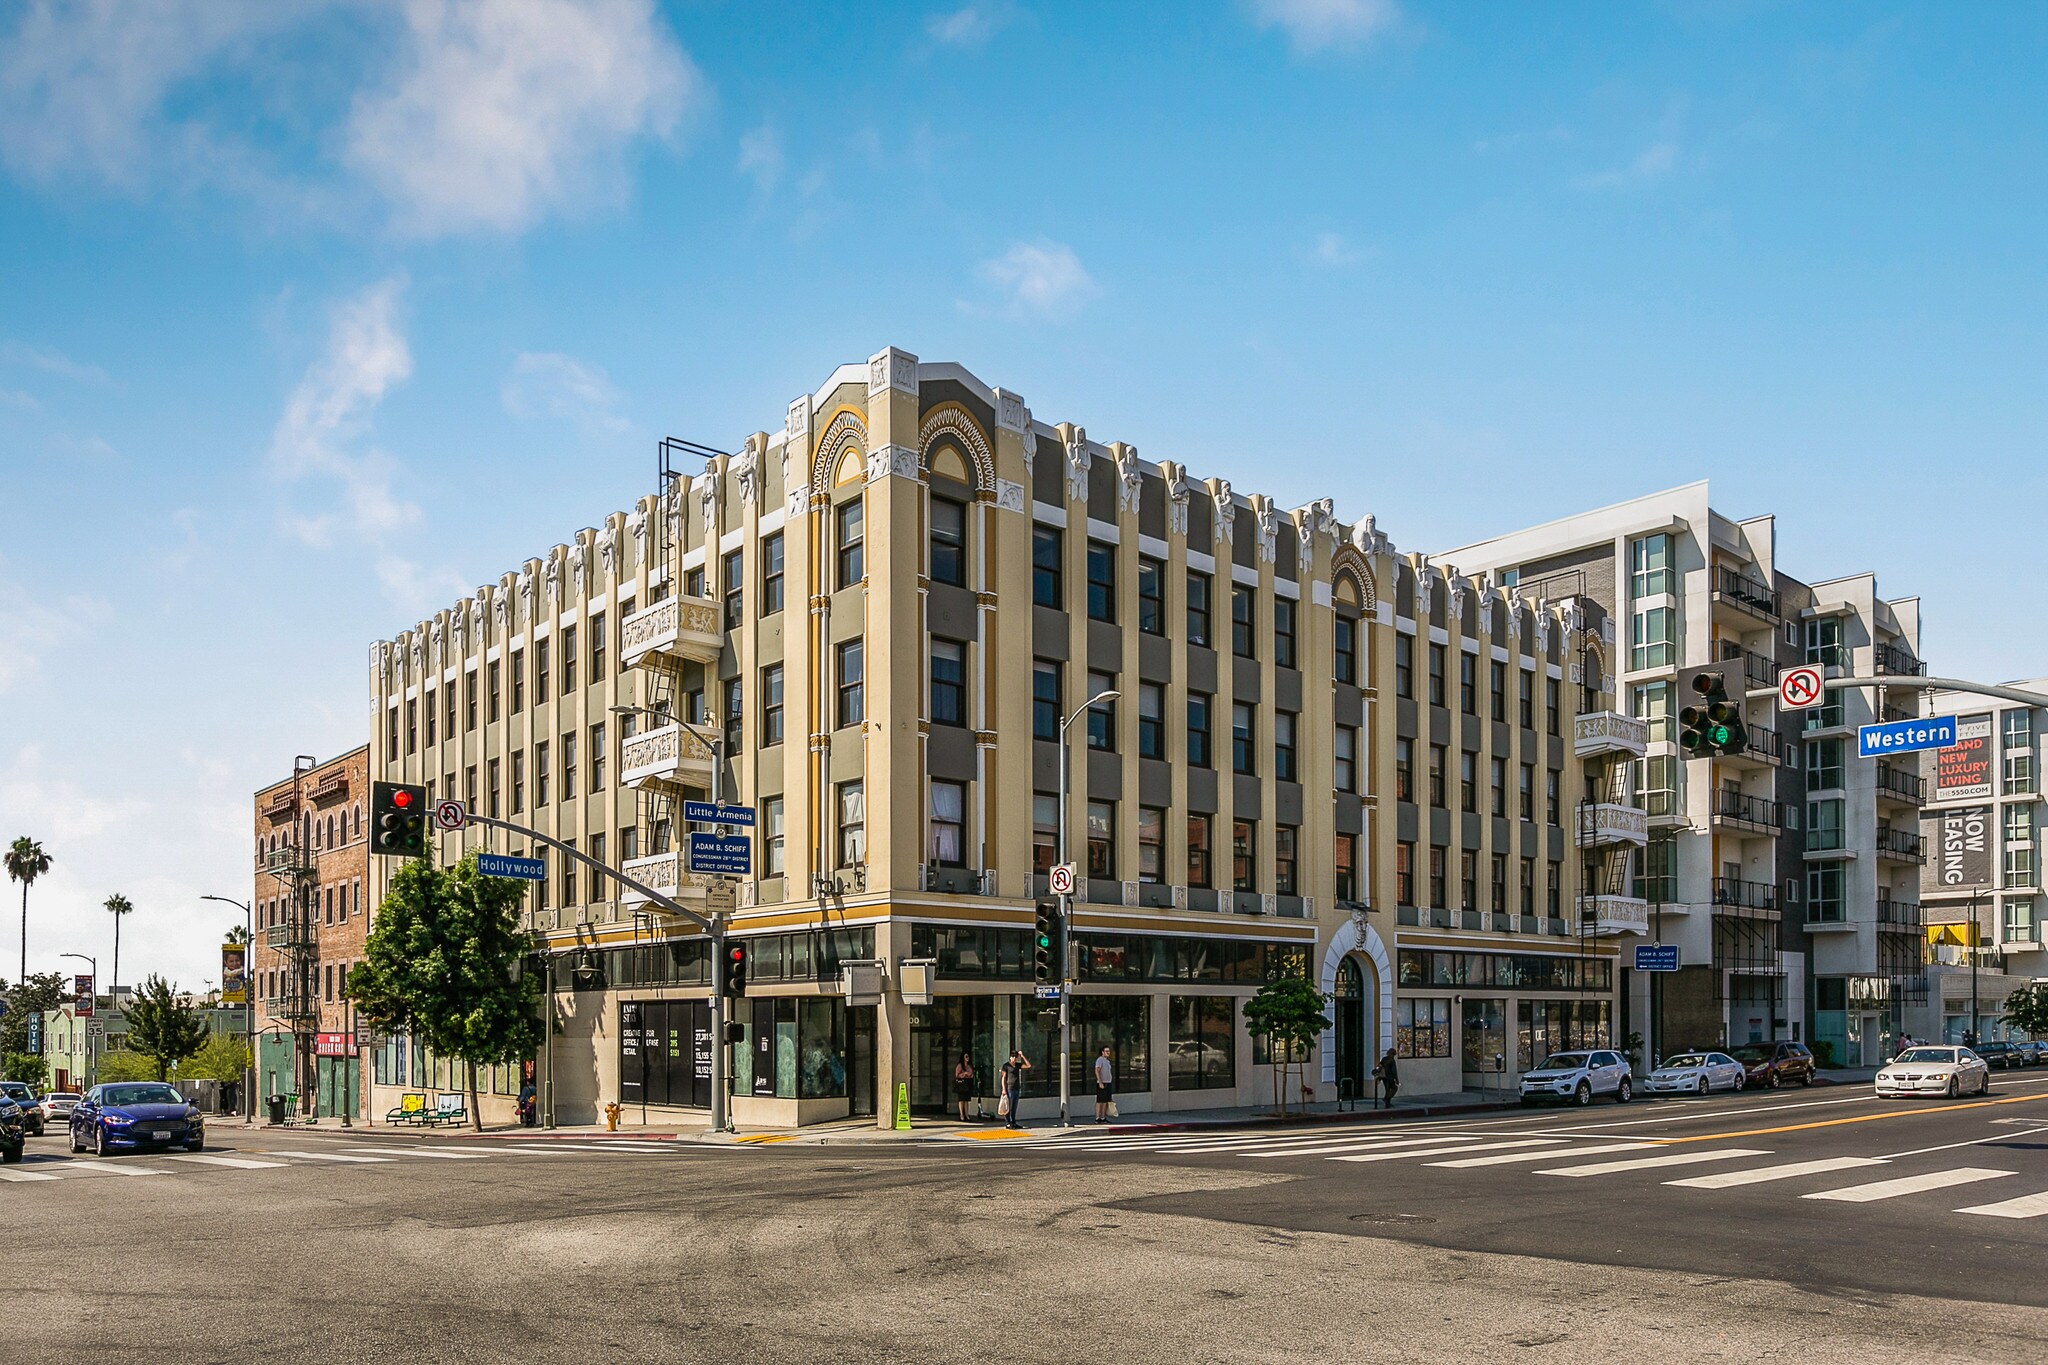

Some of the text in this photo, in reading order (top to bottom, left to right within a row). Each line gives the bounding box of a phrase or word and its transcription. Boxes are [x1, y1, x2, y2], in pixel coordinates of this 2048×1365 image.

[1865, 727, 1950, 748] Western
[1940, 752, 1968, 764] NEW
[1940, 761, 1989, 776] LUXURY
[1940, 773, 1981, 787] LIVING
[689, 807, 753, 821] Little Armenia
[1965, 807, 1984, 852] NOW
[724, 845, 747, 853] SCHIFF
[1944, 809, 1963, 885] LEASING
[480, 859, 543, 875] Hollywood
[88, 1027, 103, 1036] 35
[318, 1043, 334, 1053] CHECK
